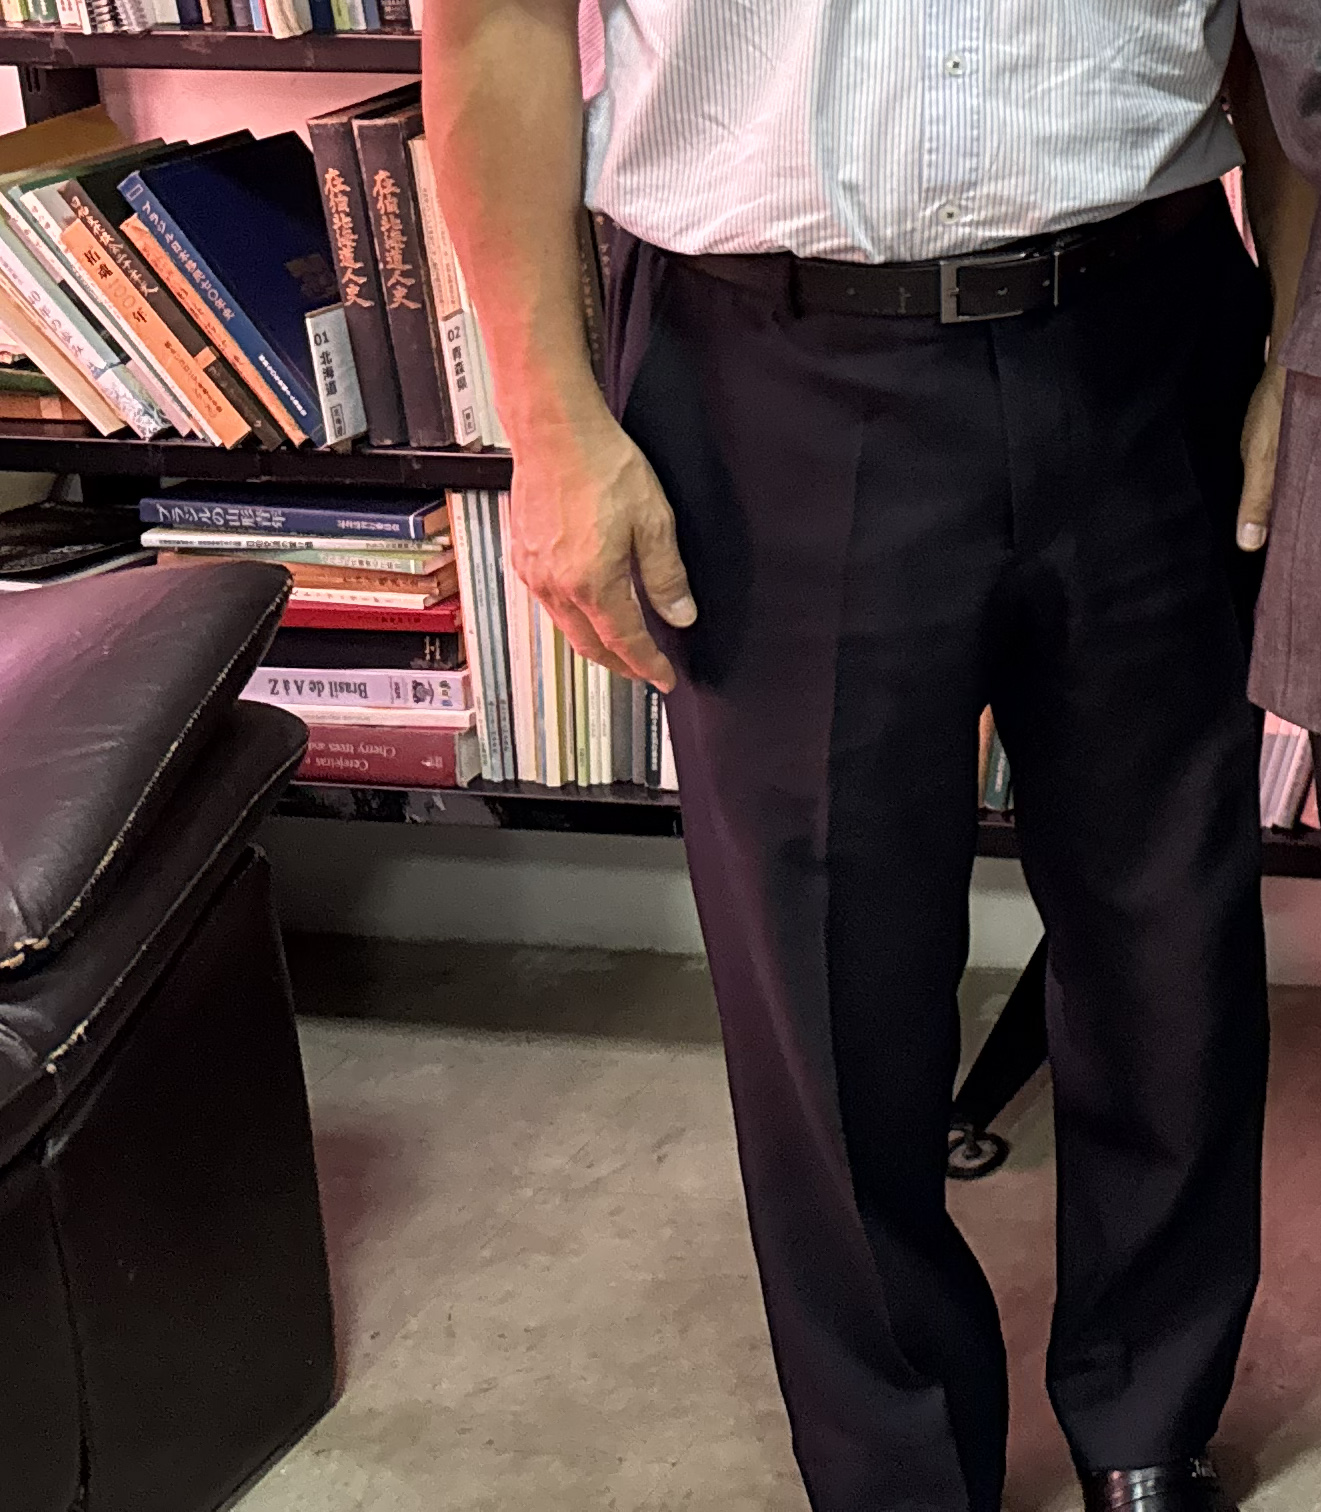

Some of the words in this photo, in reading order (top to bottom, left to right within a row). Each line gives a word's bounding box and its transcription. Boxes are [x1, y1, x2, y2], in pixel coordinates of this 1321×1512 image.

[323, 168, 374, 308] 在伯北海道人史
[372, 169, 422, 311] 在伯北海道人史
[313, 330, 331, 345] 01
[446, 326, 462, 343] 02
[319, 350, 339, 398] 北海道
[269, 677, 281, 696] Z
[294, 678, 306, 697] A
[307, 679, 325, 699] de
[326, 679, 368, 701] Brasil
[327, 742, 354, 755] trees
[358, 739, 396, 758] Cherry
